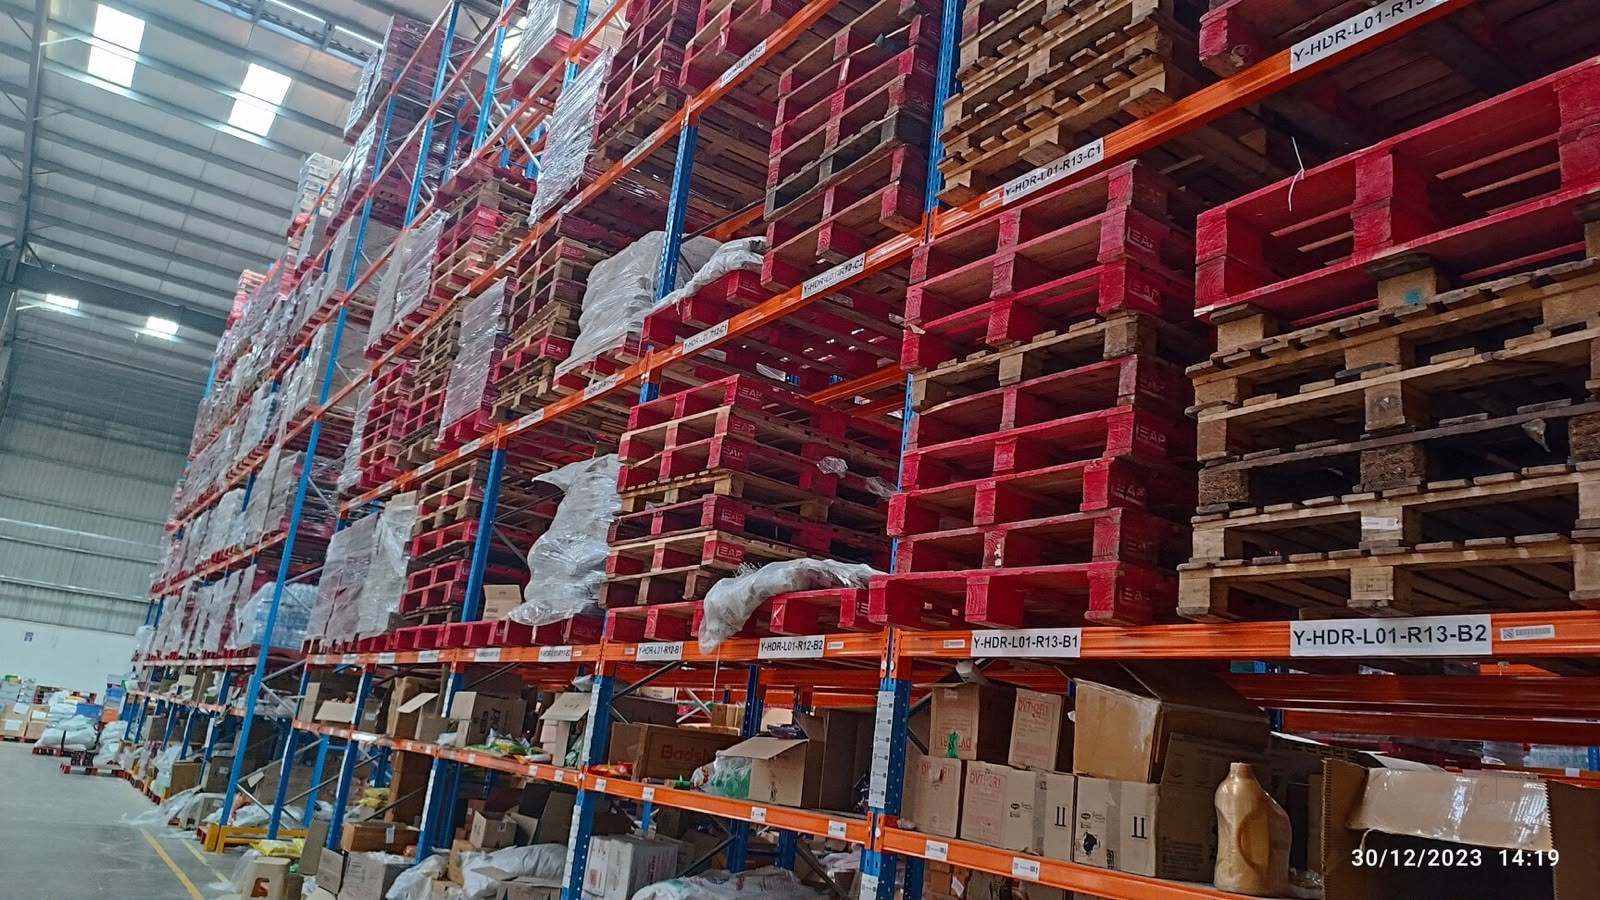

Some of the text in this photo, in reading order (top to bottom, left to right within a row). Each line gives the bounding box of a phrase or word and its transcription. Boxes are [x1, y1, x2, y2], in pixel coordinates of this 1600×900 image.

[1005, 144, 1101, 196] Y-HDR-L01-R13-C1
[1135, 423, 1166, 451] LEAP
[717, 544, 742, 562] LEAP
[974, 634, 1078, 649] Y-HDR-L01-R13-B1
[1293, 624, 1487, 646] Y-HDR-L01-R13-B2
[761, 640, 823, 652] Y-HDR-L01-R12-B2
